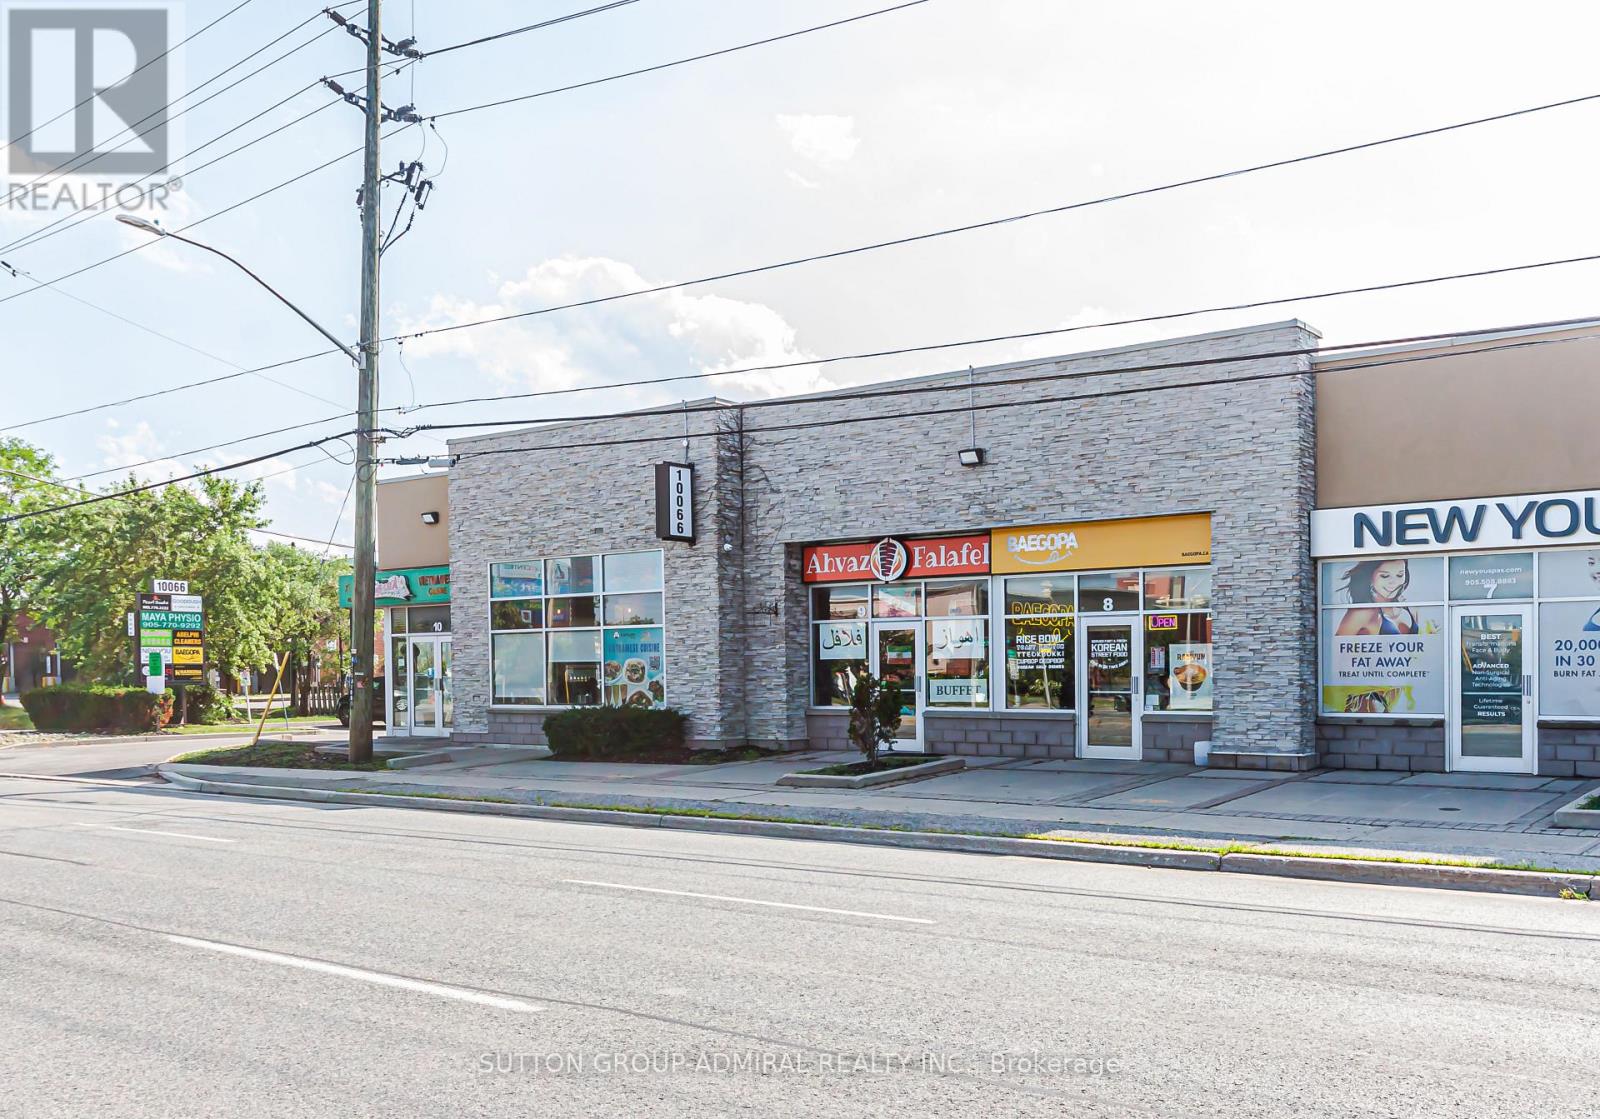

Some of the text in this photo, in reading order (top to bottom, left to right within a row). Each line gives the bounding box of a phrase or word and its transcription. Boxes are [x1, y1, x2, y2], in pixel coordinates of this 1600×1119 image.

[676, 469, 684, 534] 10066
[1353, 504, 1487, 548] NEW
[1007, 532, 1078, 552] BAEGOPA
[806, 542, 990, 574] Ahvaz Falafel
[156, 582, 186, 592] 10066
[1483, 583, 1498, 599] 7
[1102, 597, 1114, 611] 8
[141, 612, 202, 622] MAYA PHYSIO
[1151, 615, 1176, 628] OPEN
[142, 621, 201, 629] 905-770-9292
[432, 621, 443, 632] 10
[1016, 635, 1037, 644] RICE
[1480, 633, 1502, 641] BEST
[1091, 643, 1128, 652] KOREAN
[1339, 641, 1425, 653] FREEZE YOUR
[1554, 639, 1600, 653] 20,00
[1351, 656, 1412, 668] FAT AWAY
[1472, 662, 1510, 670] ADVANCED
[1555, 655, 1596, 667] IN 30
[1362, 670, 1385, 678] UNTIL
[1553, 670, 1597, 678] BURN FAT
[936, 685, 981, 696] BUFFET
